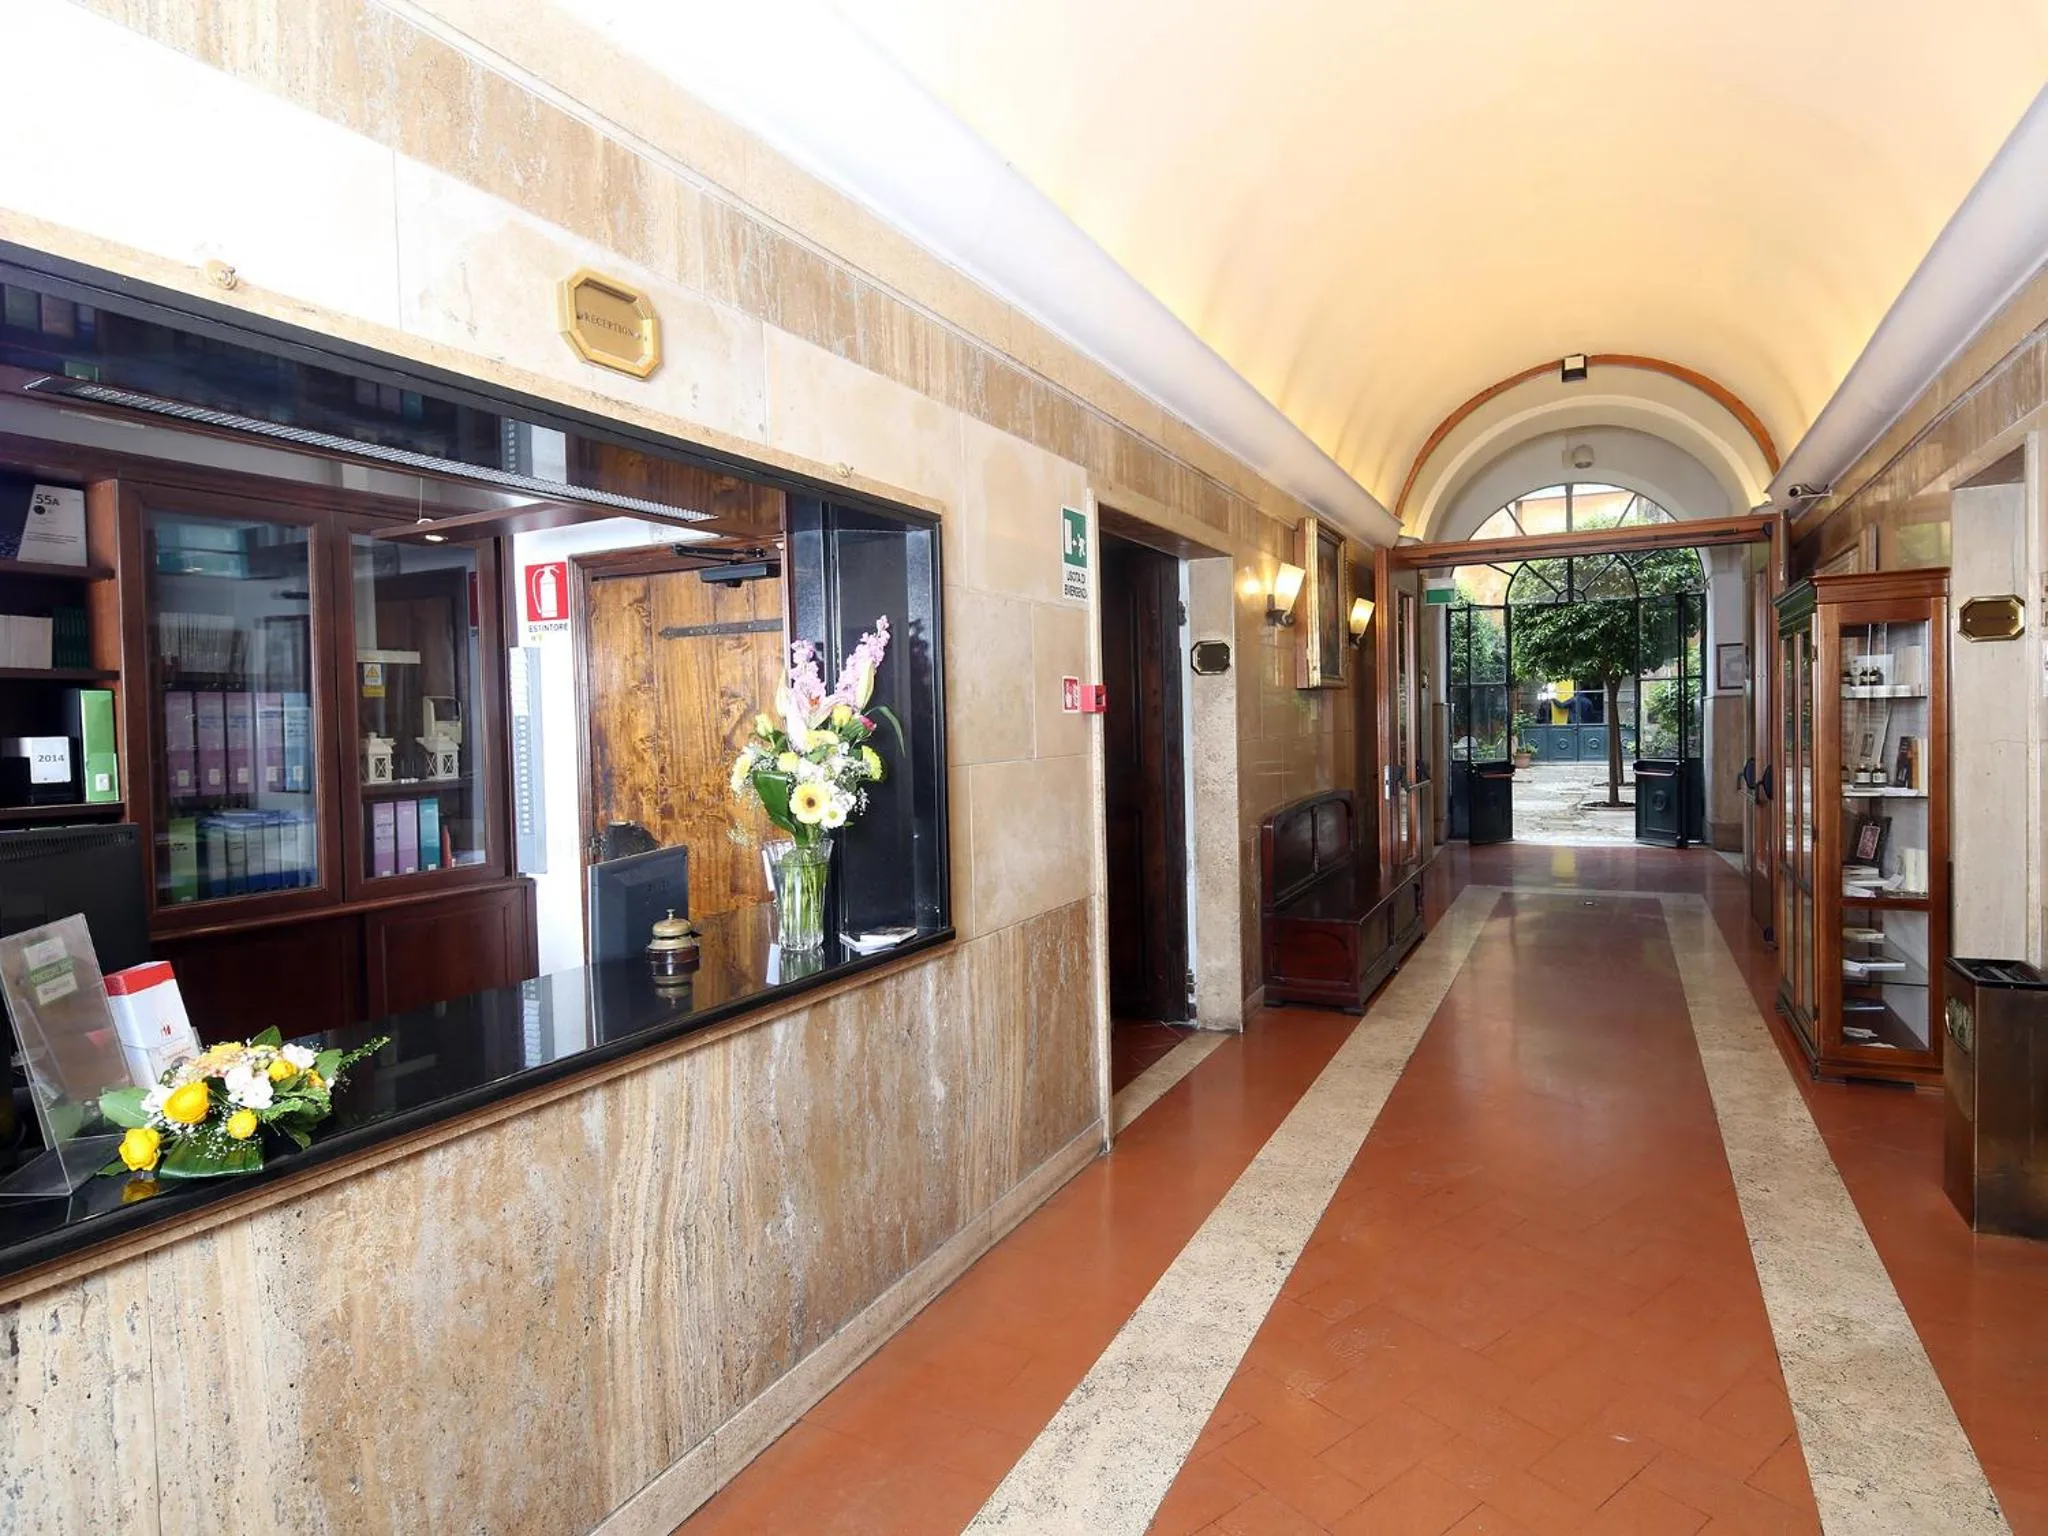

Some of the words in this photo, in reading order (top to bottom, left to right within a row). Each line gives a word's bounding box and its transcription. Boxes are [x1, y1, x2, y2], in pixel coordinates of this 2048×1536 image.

[584, 312, 634, 337] RECEPTION
[35, 493, 60, 506] 55A
[529, 623, 568, 633] ESTINTORE
[38, 754, 65, 763] 2014
